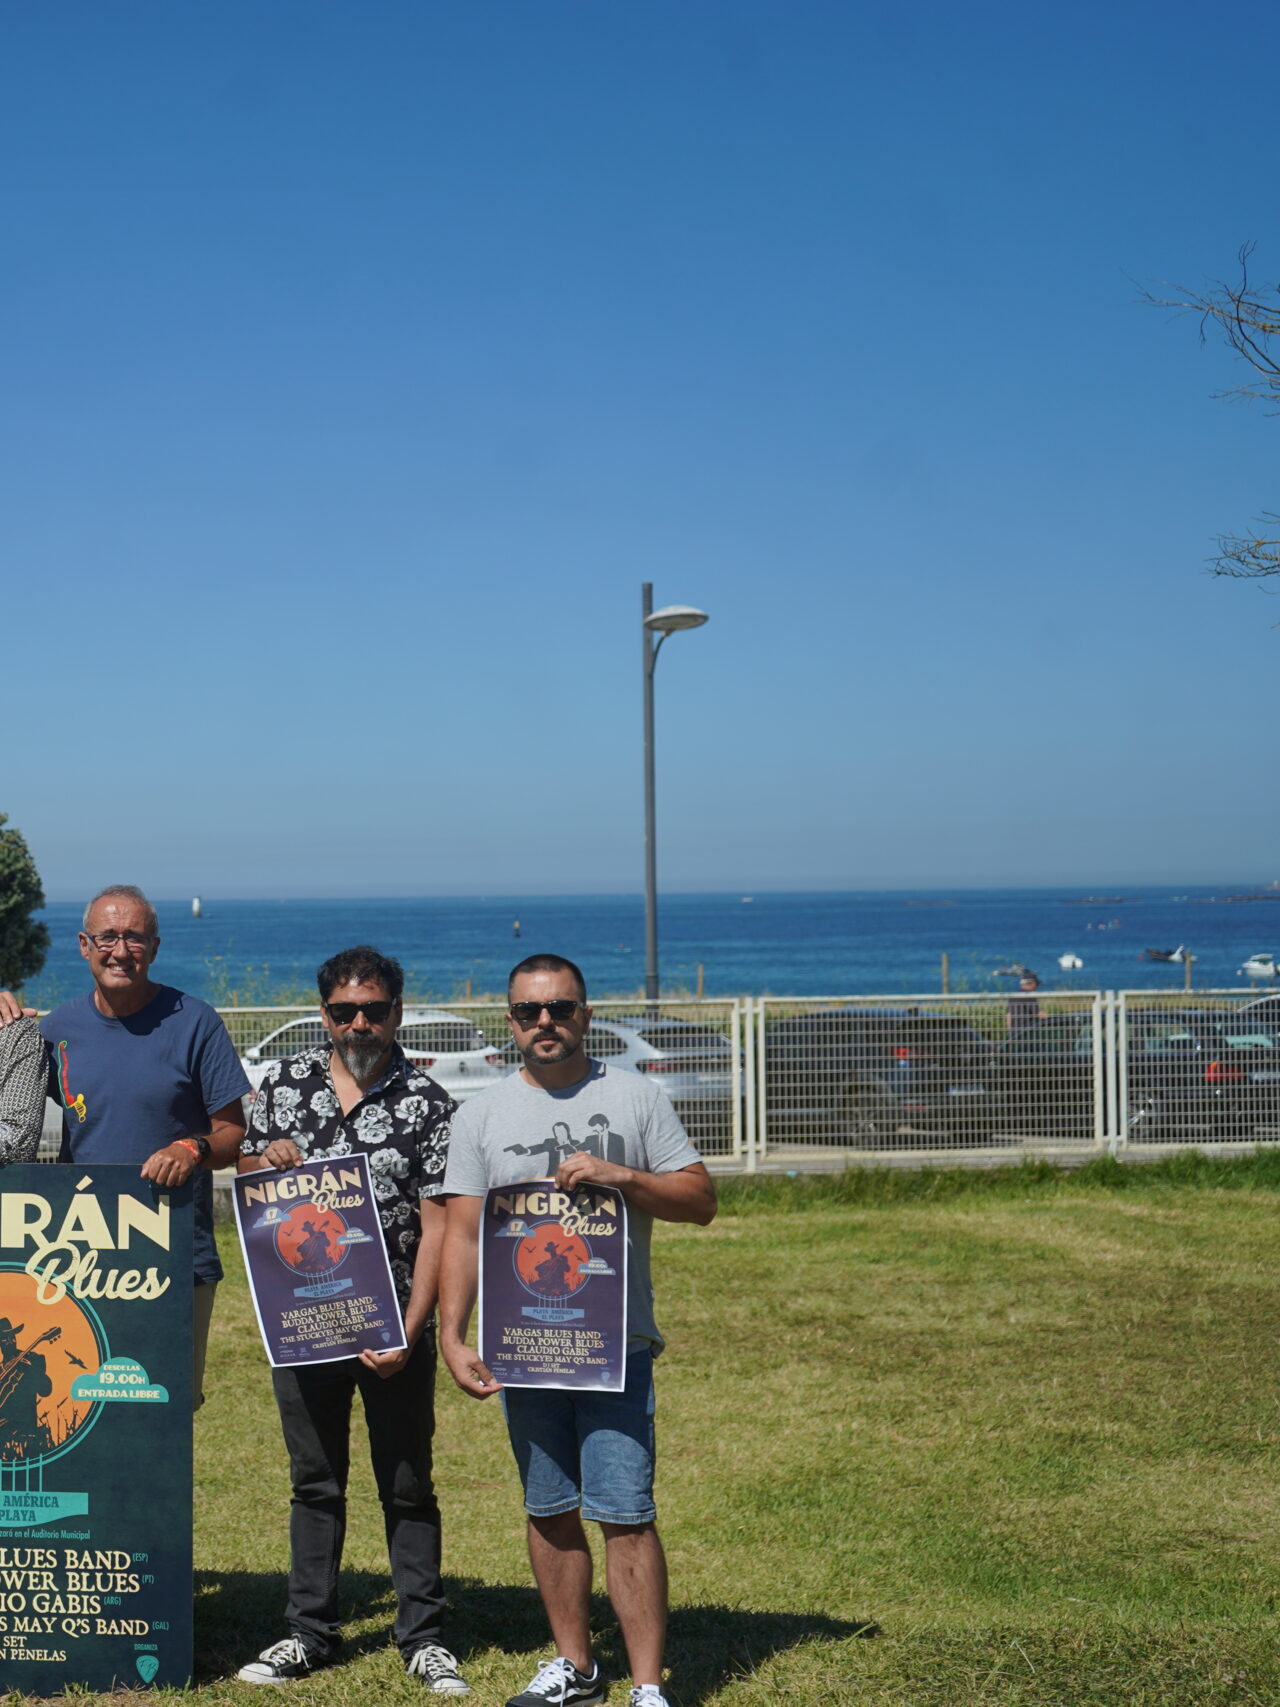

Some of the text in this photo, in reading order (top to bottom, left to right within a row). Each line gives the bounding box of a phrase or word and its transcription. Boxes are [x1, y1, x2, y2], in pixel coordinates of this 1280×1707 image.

[244, 1165, 362, 1207] NIGRÁN
[311, 1190, 364, 1213] Blues
[266, 1209, 277, 1220] 17
[510, 1222, 523, 1231] 17
[560, 1213, 616, 1237] Blues
[25, 1241, 170, 1305] Blues
[281, 1307, 318, 1320] VARGAS
[319, 1301, 345, 1311] BLUES
[347, 1296, 373, 1307] BAND
[282, 1304, 378, 1328] BUDDA POWER BLUES
[280, 1335, 295, 1343] THE
[297, 1329, 334, 1342] STUCKYES
[336, 1326, 351, 1334] MAY
[365, 1320, 385, 1329] BAND
[298, 1315, 365, 1333] CLAUDIO GABIS
[503, 1336, 604, 1348] BUDDA POWER BLUES
[504, 1328, 601, 1339] VARGAS BLUES BAND
[514, 1354, 553, 1362] STUCKYES
[517, 1345, 589, 1356] CLAUDIO GABIS
[78, 1389, 160, 1398] ENTRADA LIBRE
[3, 1493, 59, 1508] AMÉRICA
[24, 1529, 30, 1538] el
[31, 1529, 59, 1539] Auditorio
[61, 1530, 90, 1540] Municipal
[64, 1549, 131, 1570] BAND
[133, 1553, 148, 1563] (ESP)
[66, 1571, 140, 1593] BLUES
[142, 1574, 154, 1584] (PT)
[32, 1593, 101, 1614] GABIS
[103, 1596, 122, 1606] (ARG)
[13, 1616, 57, 1633] MAY
[96, 1619, 149, 1636] BAND
[152, 1621, 170, 1631] (GAL)
[3, 1636, 27, 1647] SET
[10, 1649, 66, 1661] PENELAS
